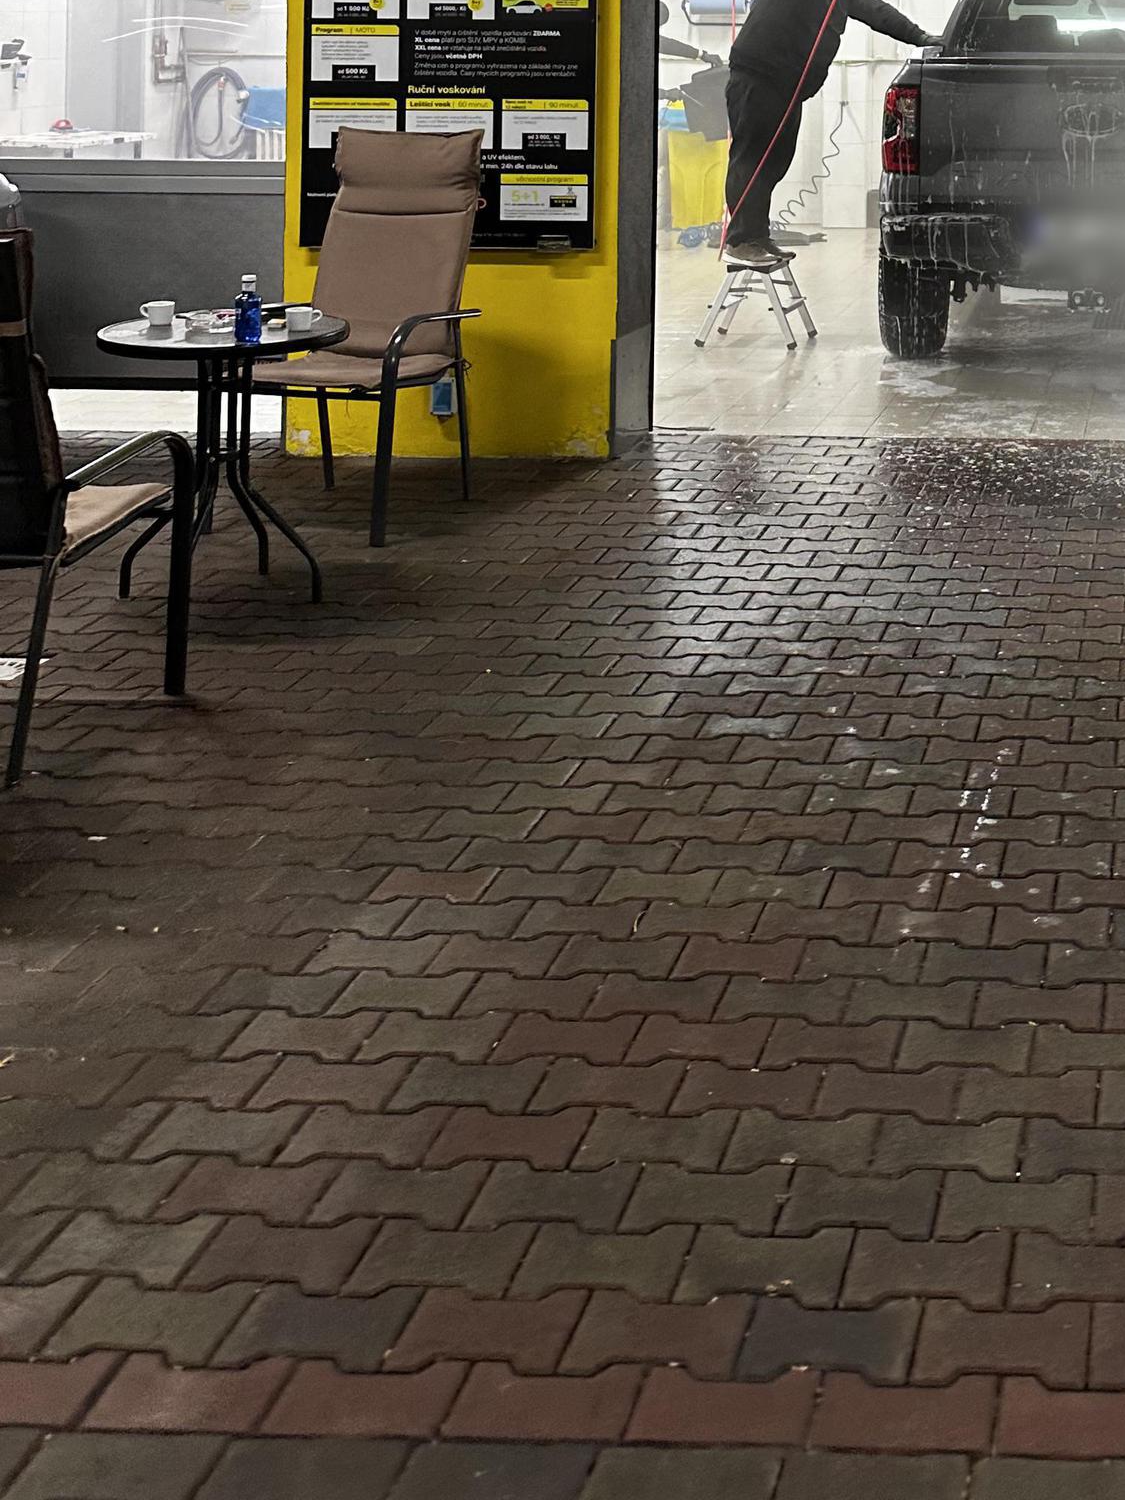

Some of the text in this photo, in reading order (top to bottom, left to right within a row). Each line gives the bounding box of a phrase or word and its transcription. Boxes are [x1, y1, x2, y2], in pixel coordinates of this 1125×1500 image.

[407, 84, 486, 94] Ruční voskování
[511, 189, 539, 202] 5+1
